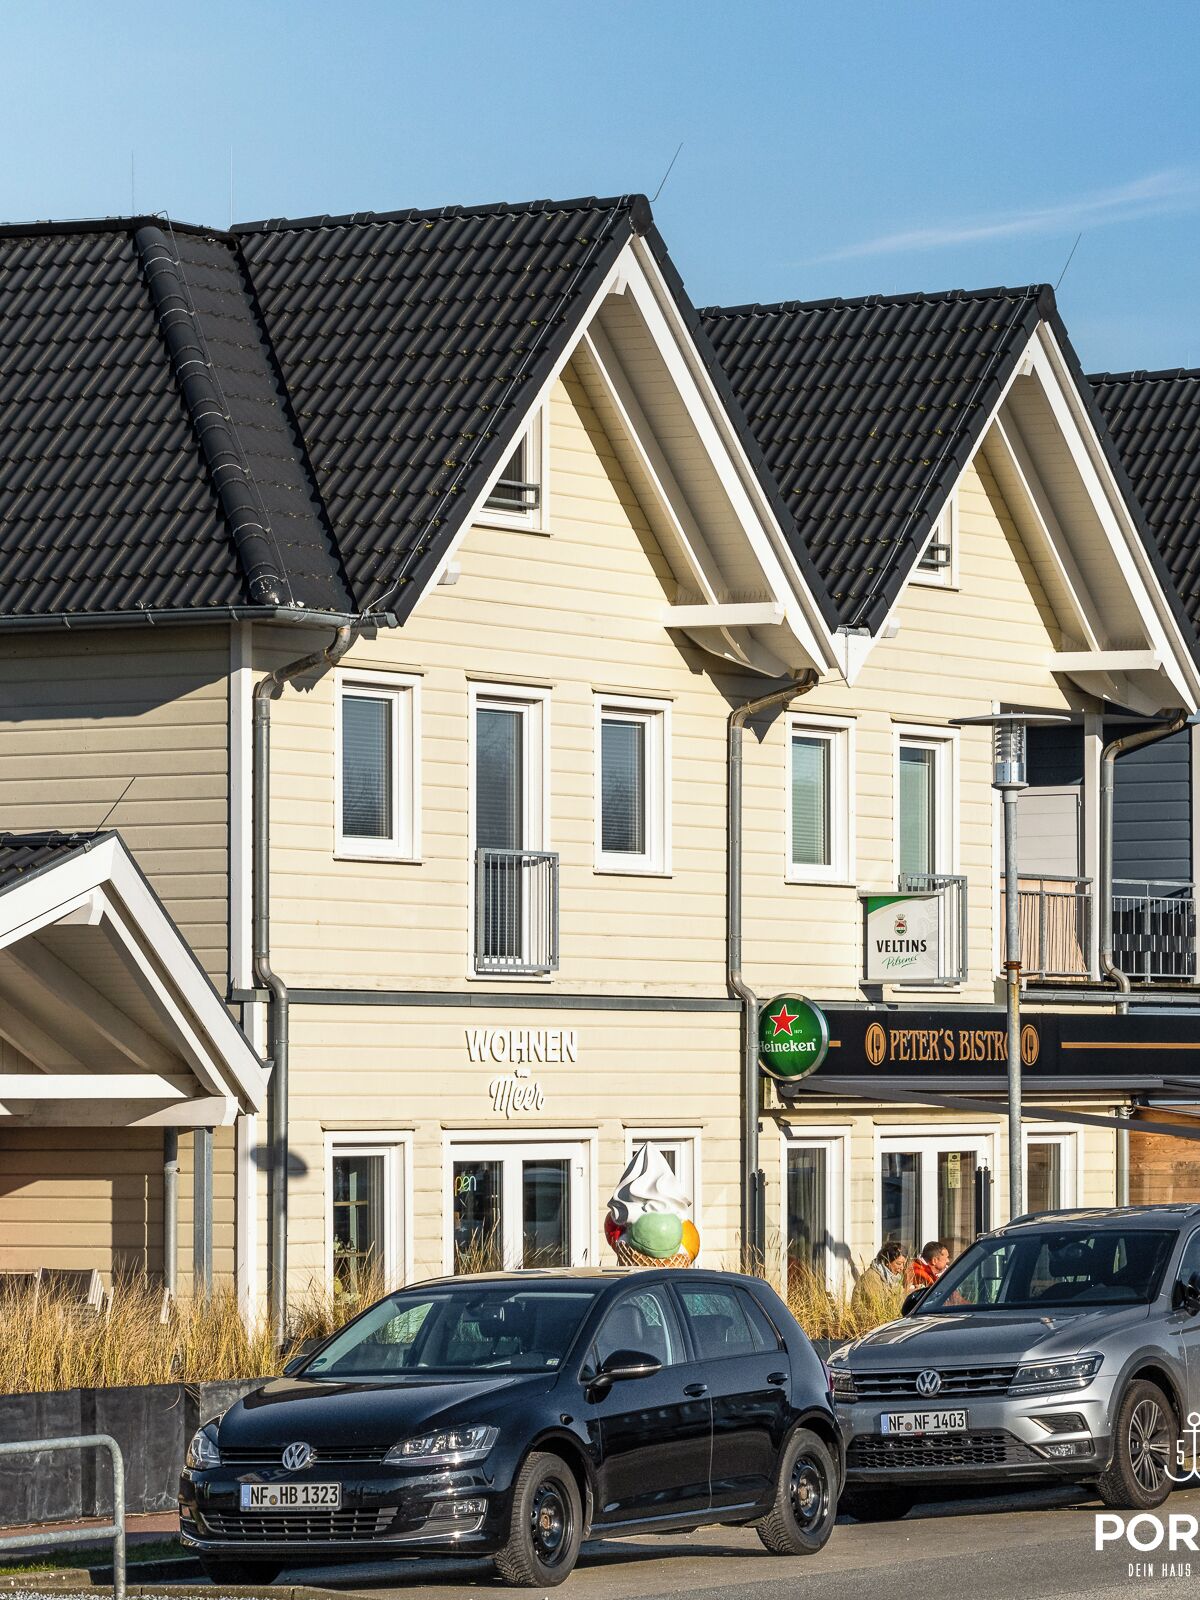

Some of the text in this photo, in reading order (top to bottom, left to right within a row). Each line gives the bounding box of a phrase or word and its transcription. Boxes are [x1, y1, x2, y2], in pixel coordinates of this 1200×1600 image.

[876, 939, 927, 953] VELTINS
[464, 1029, 577, 1063] WOHNEN
[959, 1029, 1009, 1062] BISTR
[488, 1076, 545, 1120] Meer
[455, 1175, 477, 1197] pen
[889, 1416, 904, 1431] NF
[914, 1415, 930, 1430] NF
[933, 1413, 964, 1429] 1403
[250, 1486, 338, 1504] NF HB 1323
